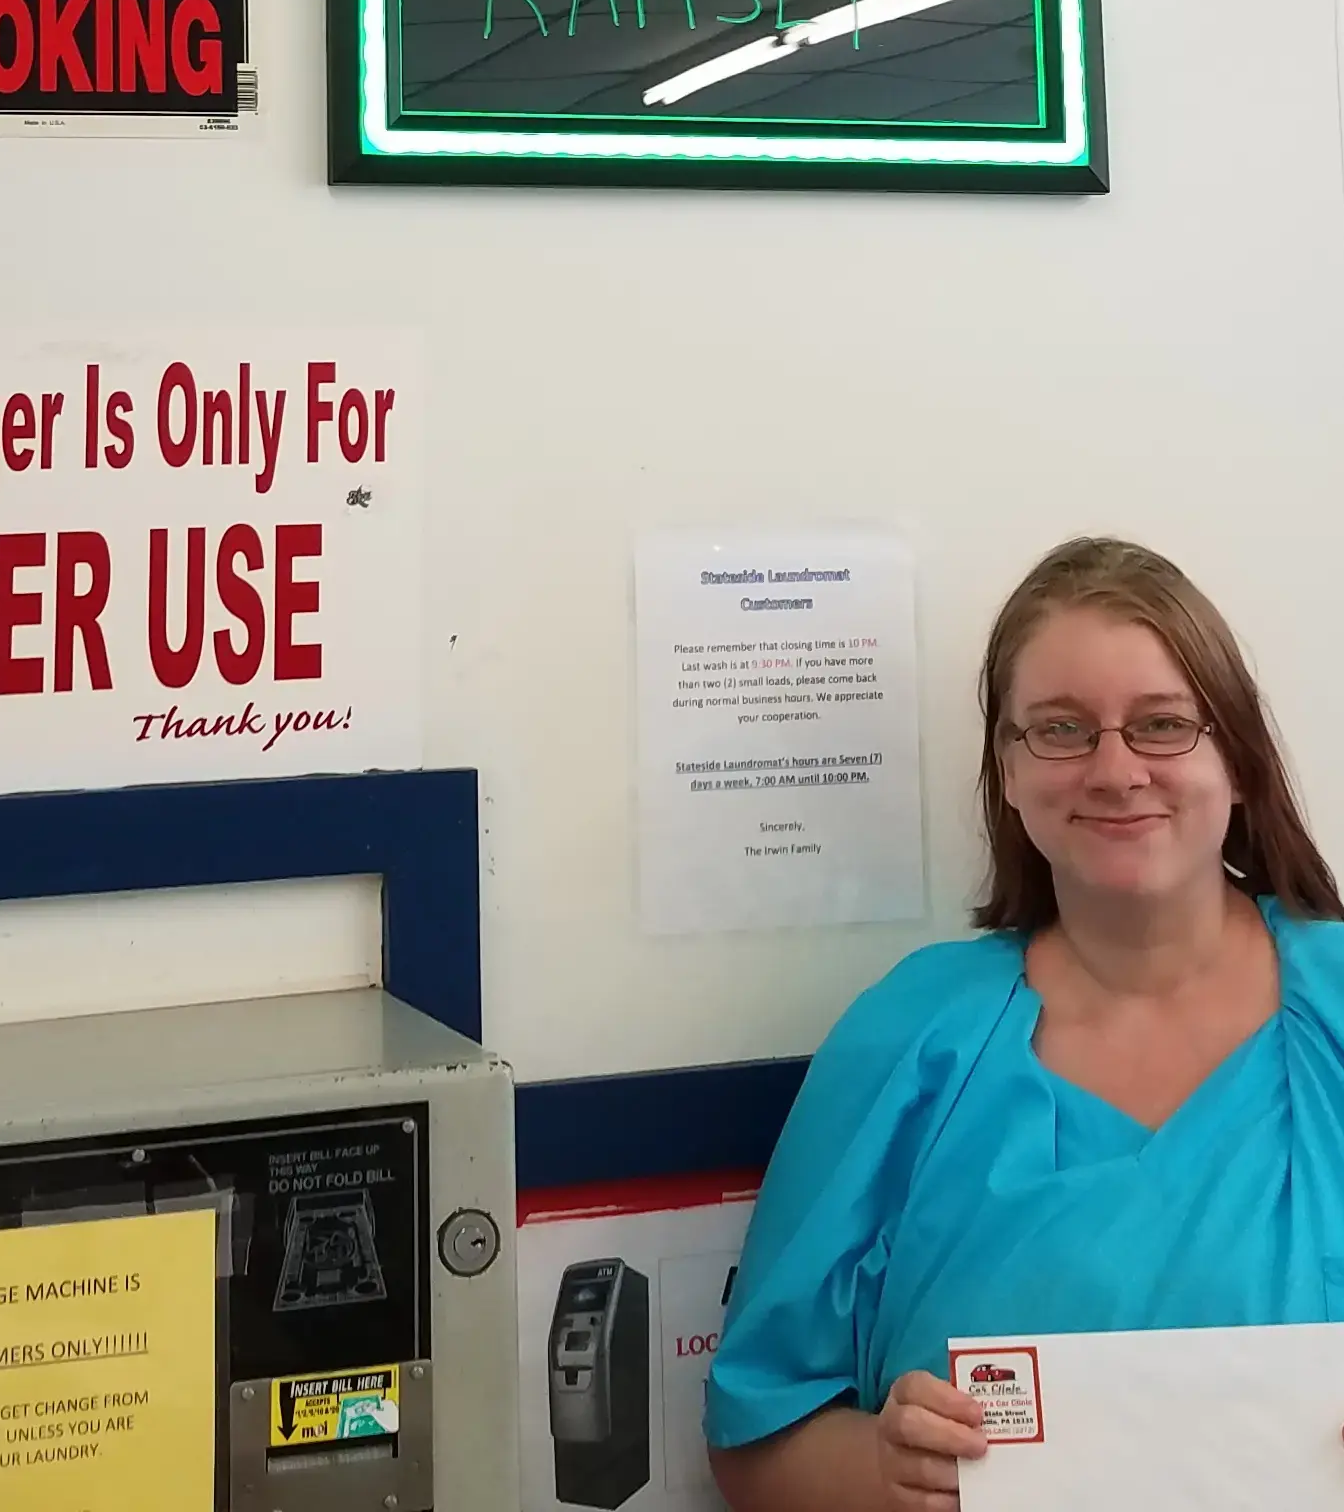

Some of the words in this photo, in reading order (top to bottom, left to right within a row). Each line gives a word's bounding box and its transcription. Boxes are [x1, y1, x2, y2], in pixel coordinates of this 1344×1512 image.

[84, 364, 135, 470] Is
[157, 362, 287, 494] Only
[305, 362, 395, 464] For
[768, 568, 850, 583] Laundromat
[148, 523, 323, 689] USE
[740, 598, 813, 611] Customers
[674, 644, 704, 653] Please
[707, 643, 756, 653] remember
[759, 642, 778, 651] that
[780, 641, 812, 651] closing
[815, 640, 836, 649] time
[839, 640, 846, 649] is
[682, 663, 700, 671] Last
[703, 662, 728, 670] wash
[730, 661, 737, 670] is
[740, 661, 749, 669] at
[805, 659, 822, 669] you
[824, 658, 846, 667] have
[849, 658, 874, 666] more
[678, 680, 700, 689] than
[703, 680, 721, 688] two
[724, 678, 736, 689] (2)
[739, 677, 763, 687] small
[766, 676, 793, 687] loads,
[796, 676, 826, 686] please
[828, 676, 854, 684] come
[856, 673, 877, 683] back
[672, 697, 703, 708] during
[706, 696, 739, 705] normal
[742, 695, 782, 704] business
[816, 693, 832, 701] We
[834, 691, 884, 703] appreciate
[133, 701, 269, 745] Thank
[261, 704, 354, 752] you!
[738, 714, 759, 724] your
[762, 711, 821, 723] cooperation.
[676, 761, 721, 773] Stateside
[724, 758, 790, 770] Laundromat's
[792, 756, 819, 767] hours
[822, 757, 837, 765] are
[839, 754, 867, 765] Seven
[869, 753, 882, 765] (7)
[690, 780, 713, 791] days
[724, 777, 753, 788] week,
[755, 776, 776, 786] 7:00
[778, 775, 795, 784] AM
[798, 774, 820, 784] until
[823, 773, 848, 783] 10:00
[745, 847, 762, 856] The
[764, 845, 788, 854] Irwin
[791, 843, 821, 854] Family
[335, 1146, 364, 1158] FACE
[366, 1145, 380, 1155] UP
[296, 1163, 318, 1174] WAY
[269, 1179, 289, 1193] DO
[293, 1175, 322, 1191] NOT
[326, 1170, 363, 1187] FOLD
[598, 1267, 613, 1277] ATM
[26, 1276, 118, 1301] MACHINE
[124, 1273, 141, 1292] IS
[676, 1333, 718, 1357] LOC
[290, 1381, 328, 1398] INSERT
[332, 1378, 352, 1393] BILL
[357, 1374, 384, 1390] HERE
[0, 1404, 30, 1420] GET
[34, 1396, 98, 1416] CHANGE
[104, 1390, 149, 1408] FROM
[6, 1424, 64, 1444] UNLESS
[68, 1419, 101, 1436] YOU
[106, 1414, 135, 1432] ARE
[26, 1443, 103, 1465] LAUNDRY.
